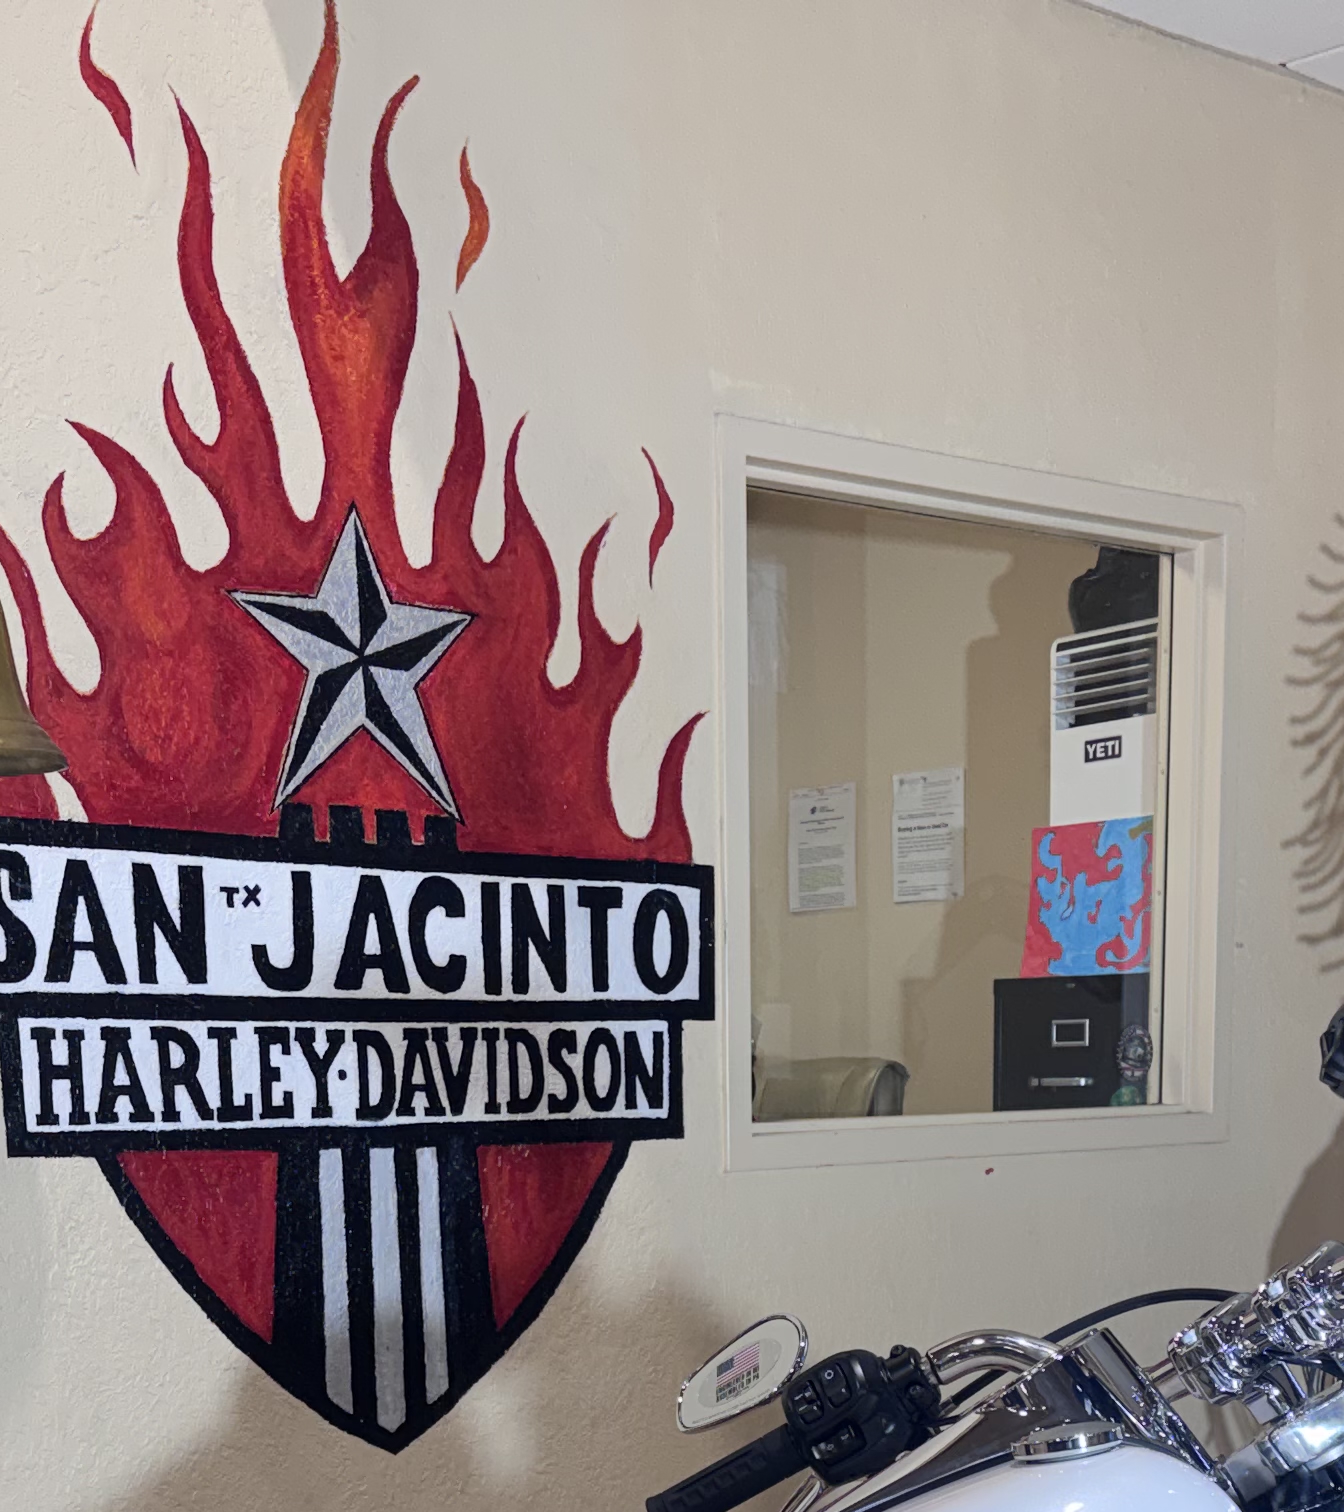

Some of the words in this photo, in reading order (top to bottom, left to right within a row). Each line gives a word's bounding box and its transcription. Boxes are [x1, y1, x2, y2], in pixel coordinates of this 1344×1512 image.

[1086, 740, 1120, 760] YETI
[219, 884, 263, 908] TX
[250, 871, 690, 996] JACINTO
